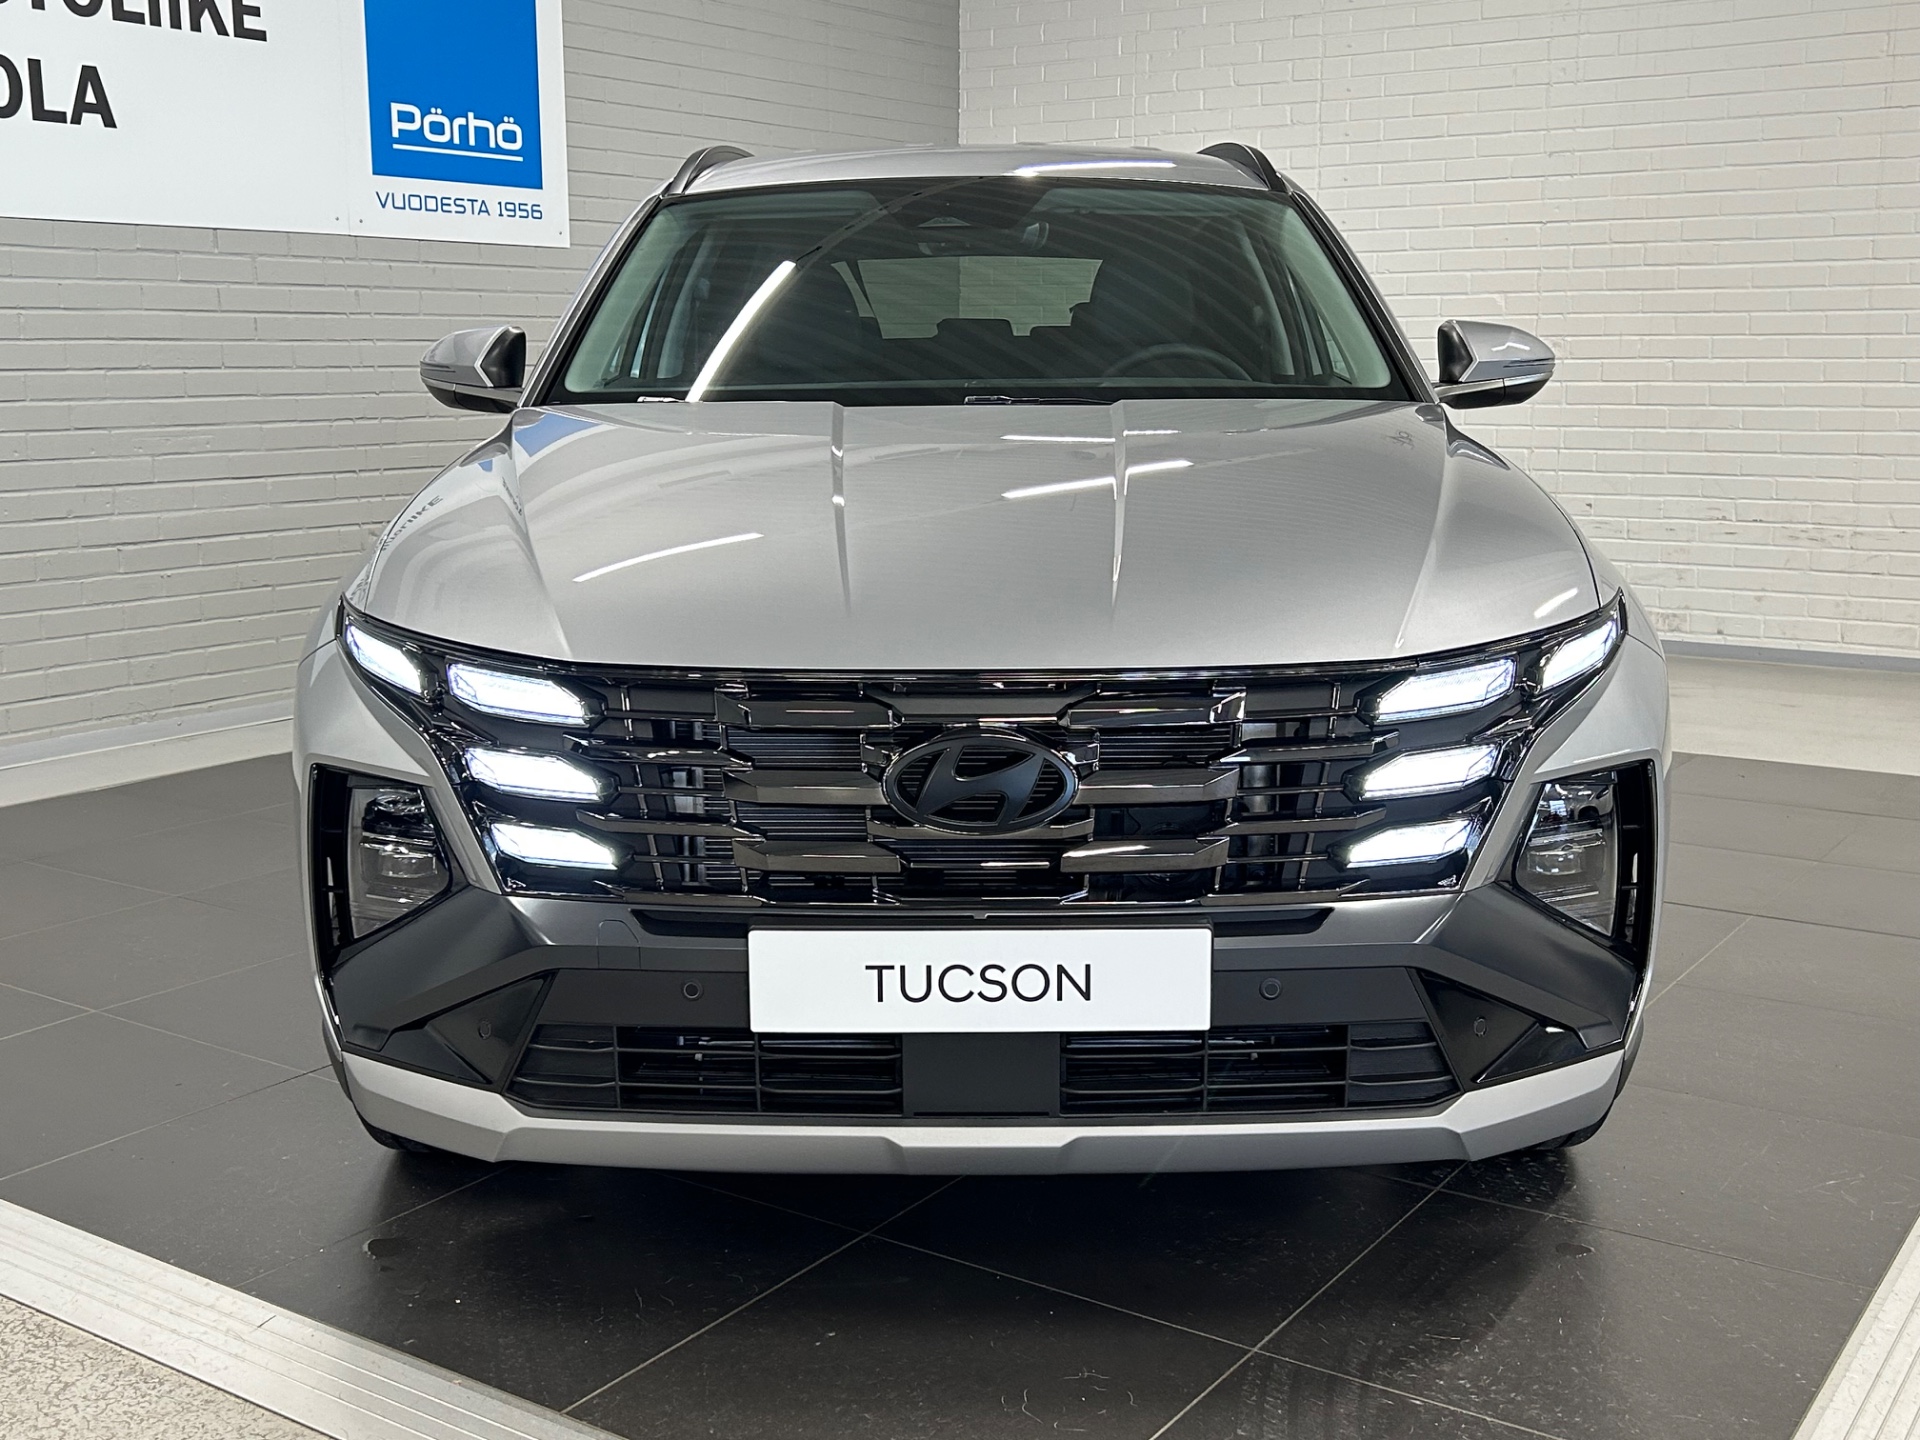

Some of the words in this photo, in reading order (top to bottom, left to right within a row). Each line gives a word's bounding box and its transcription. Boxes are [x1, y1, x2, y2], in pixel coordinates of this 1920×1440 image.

[390, 102, 523, 151] Pörhö
[375, 190, 491, 217] VUODESTA
[497, 201, 543, 220] 1956
[865, 964, 1091, 1003] TUCSON
